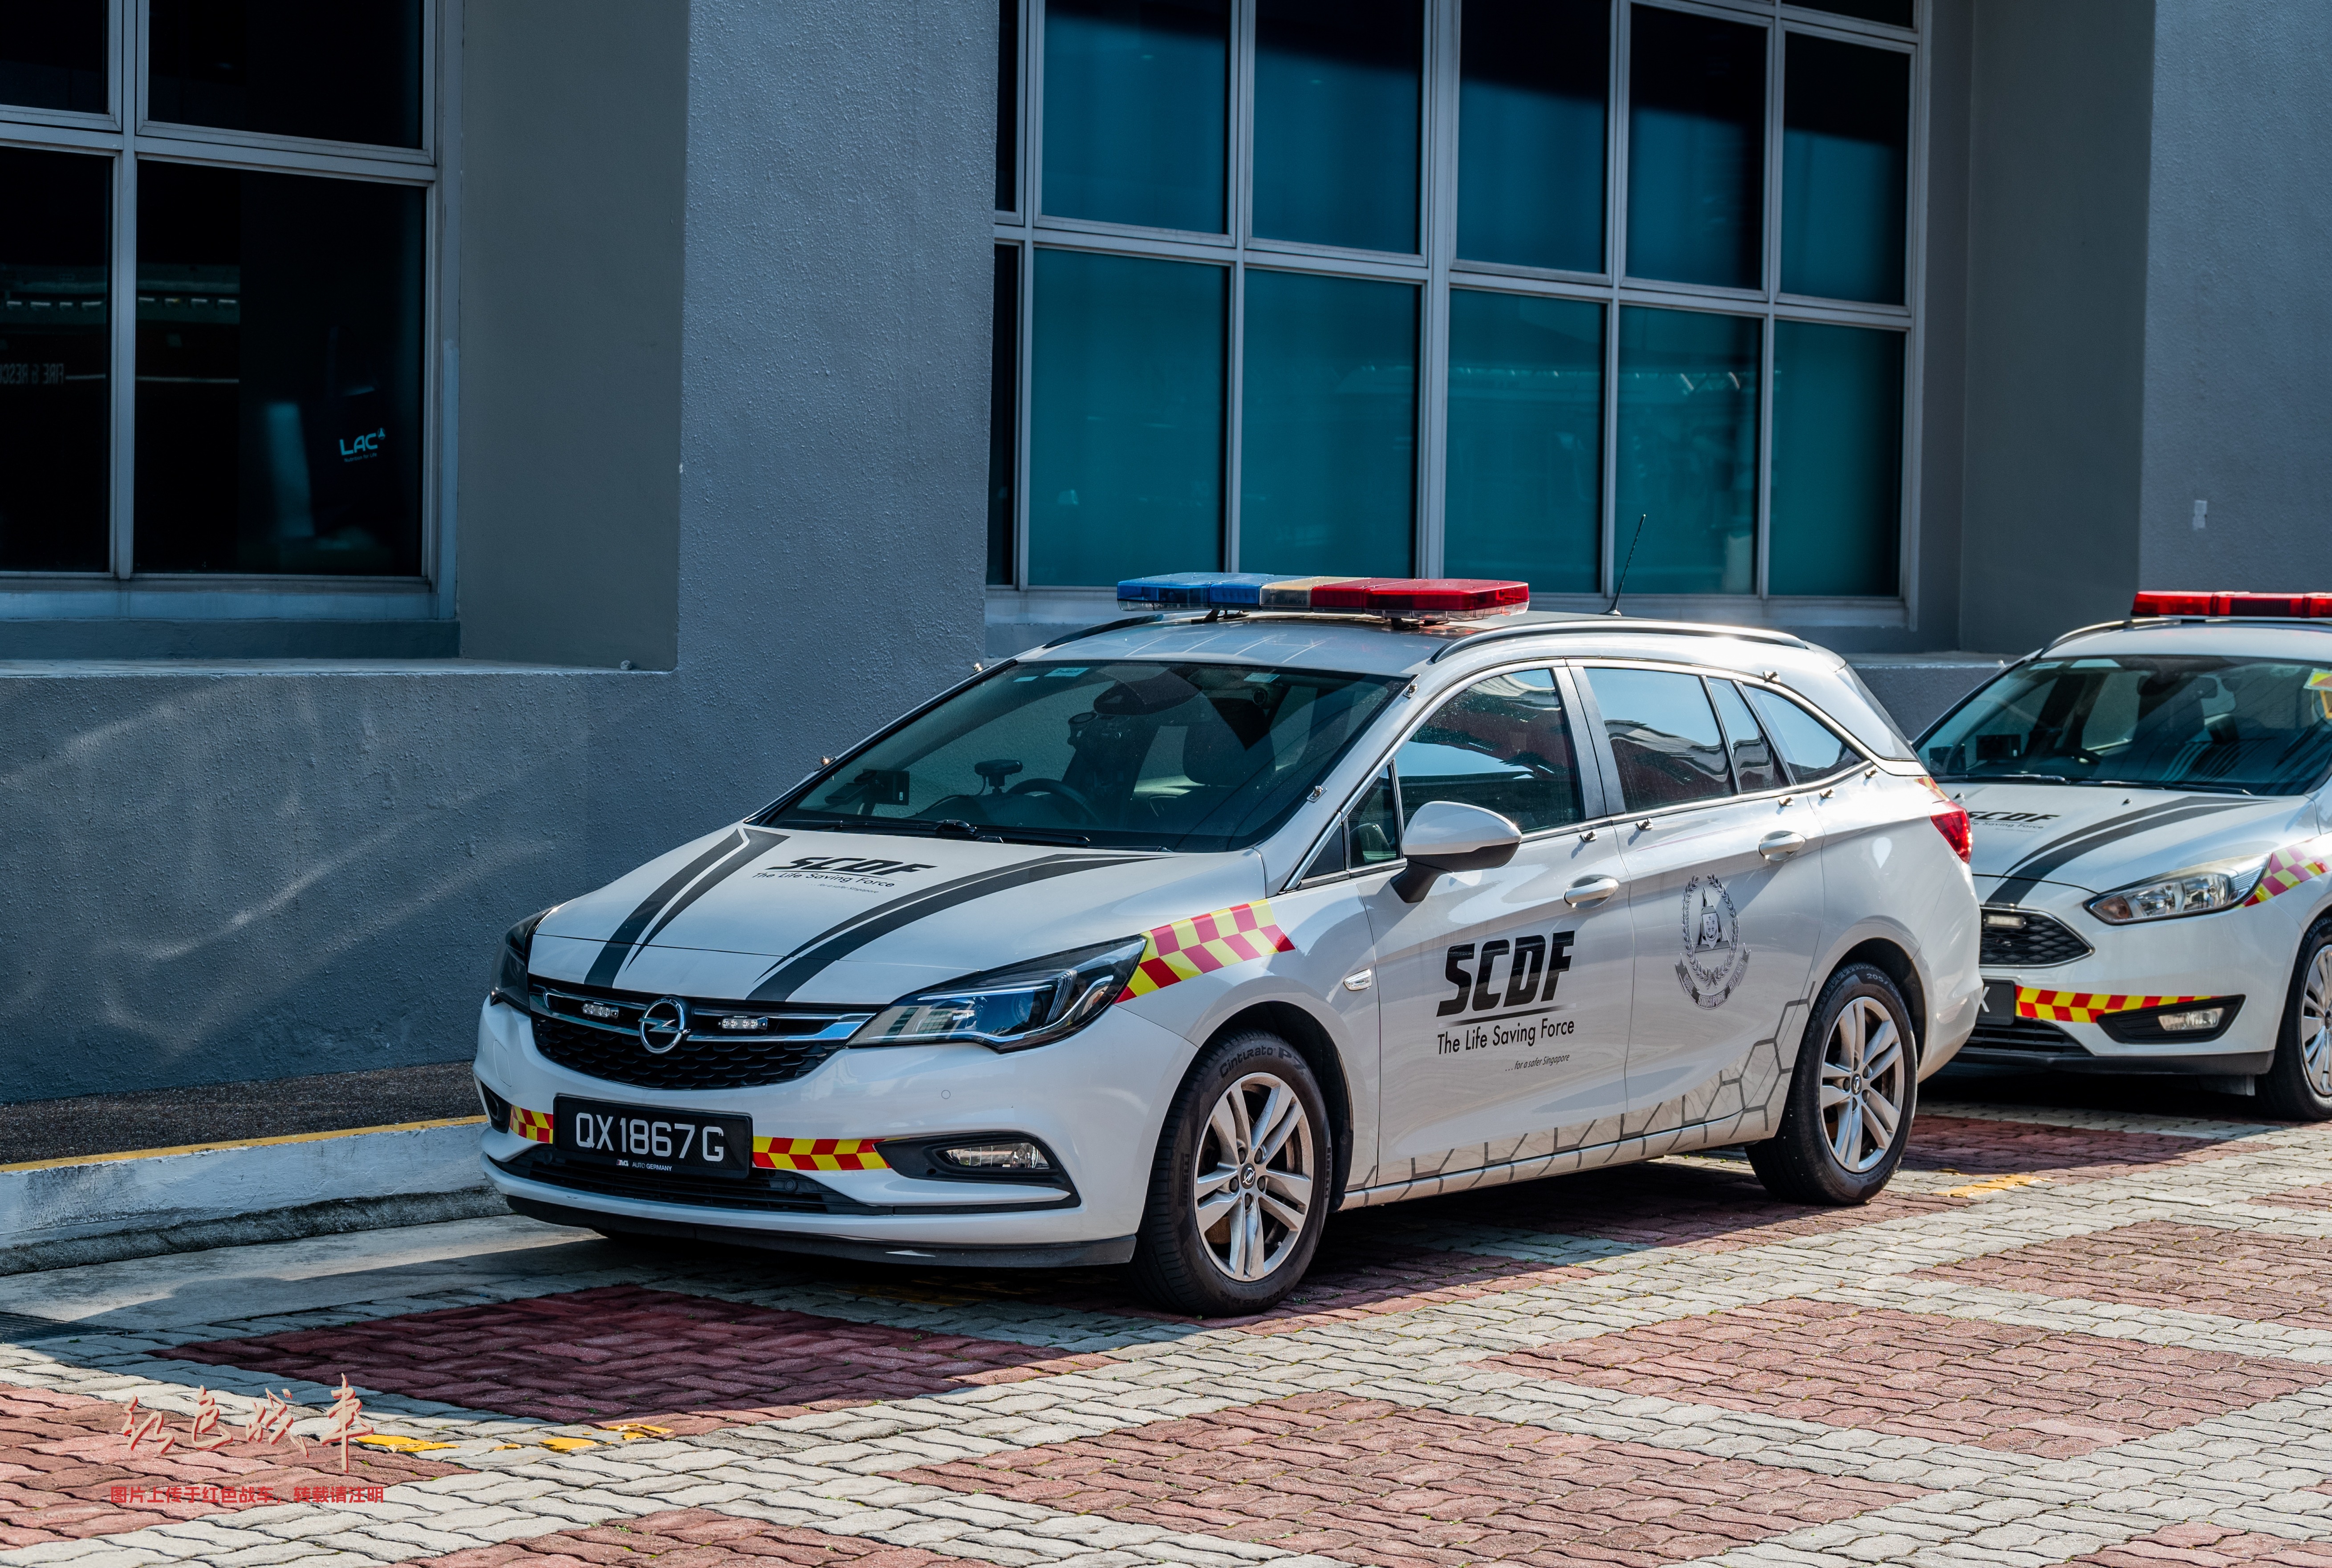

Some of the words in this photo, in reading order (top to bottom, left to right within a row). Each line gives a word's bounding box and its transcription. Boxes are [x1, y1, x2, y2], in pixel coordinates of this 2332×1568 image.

[339, 433, 378, 455] LAC
[764, 857, 938, 875] SCDF
[805, 873, 853, 883] Saving
[856, 878, 895, 887] Force
[1436, 930, 1575, 1017] SCDF
[1698, 991, 1726, 1007] SINGAPORE
[1438, 1031, 1460, 1054] The
[1466, 1026, 1487, 1050] Life
[1493, 1022, 1536, 1046] Saving
[1541, 1018, 1574, 1038] Force
[1278, 1046, 1306, 1070] P7
[1528, 1057, 1542, 1068] safer
[1543, 1054, 1570, 1066] Singapore
[576, 1113, 724, 1162] QX1867G
